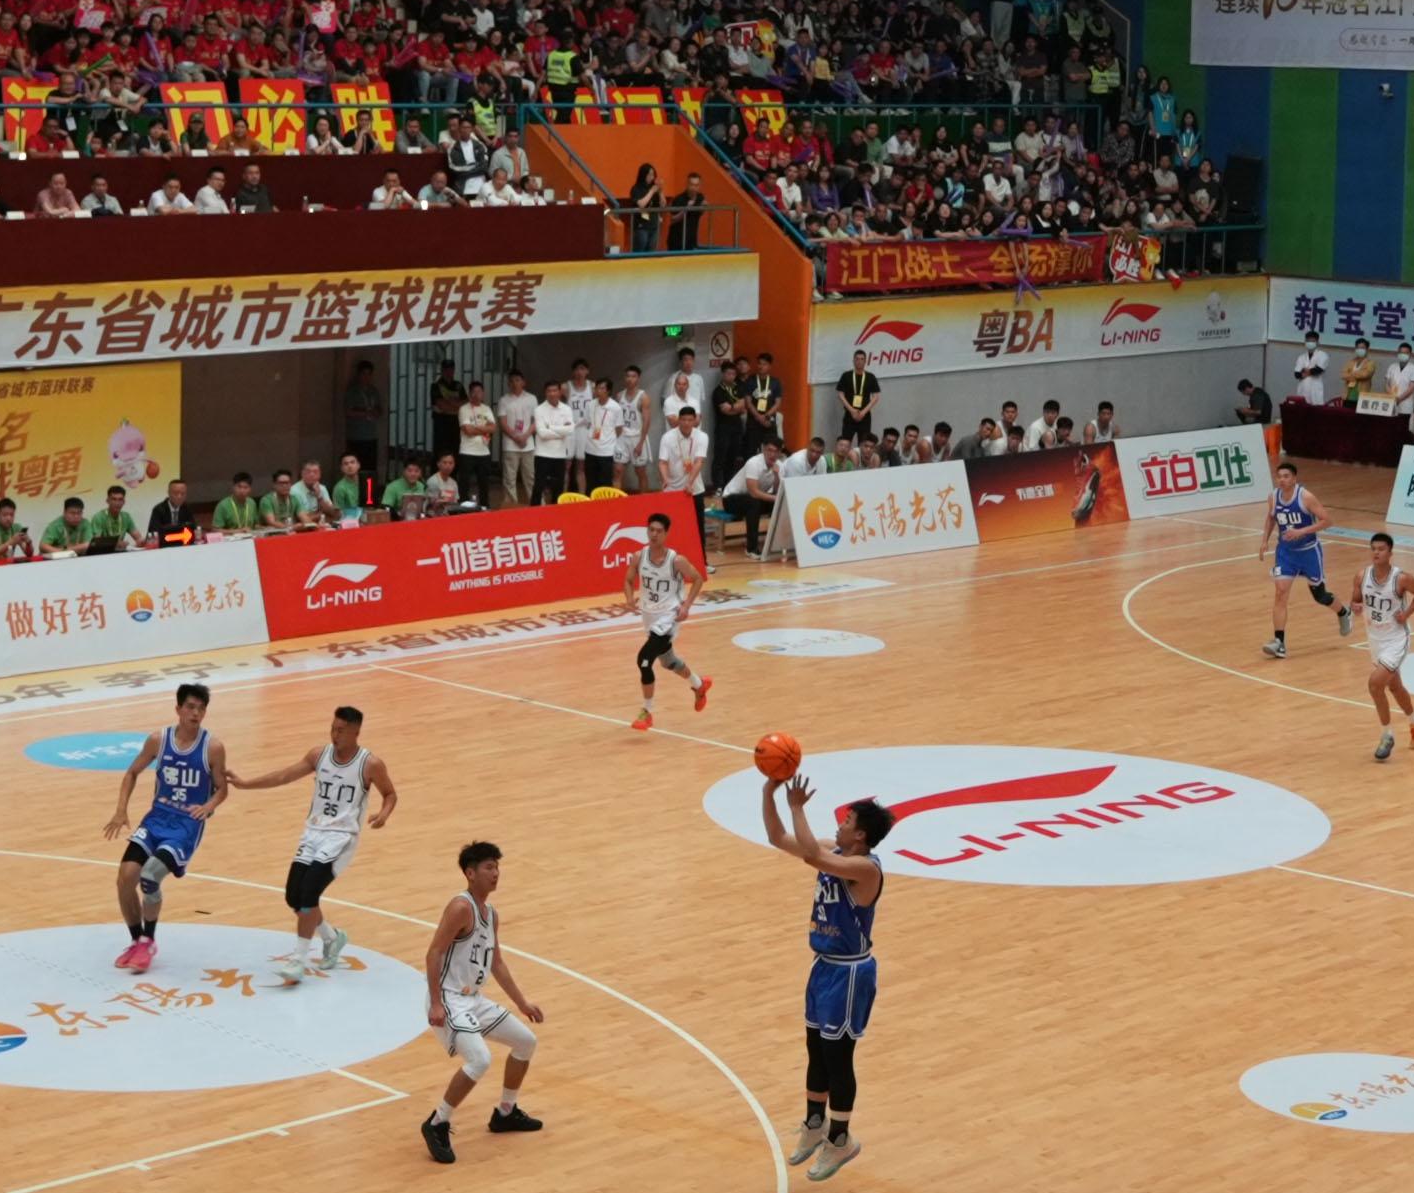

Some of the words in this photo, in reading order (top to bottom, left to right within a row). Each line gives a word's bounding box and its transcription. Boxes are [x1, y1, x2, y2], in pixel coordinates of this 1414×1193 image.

[973, 308, 1054, 358] 粤BA
[1101, 328, 1161, 346] LI-NING
[1140, 444, 1253, 497] 立白卫仕
[416, 529, 566, 576] 一切皆有可能
[449, 575, 490, 592] ANYTHING
[493, 574, 501, 586] IS
[503, 568, 544, 586] POSSIBLE
[642, 576, 670, 592] 江门
[306, 586, 382, 610] LI-NING
[649, 592, 659, 603] 30
[5, 592, 107, 639] 做好药
[163, 767, 201, 787] 佛山
[171, 788, 186, 801] 35
[318, 780, 355, 803] 江门
[323, 802, 338, 817] 25
[894, 781, 1236, 866] LI-NING
[475, 971, 484, 985] 2
